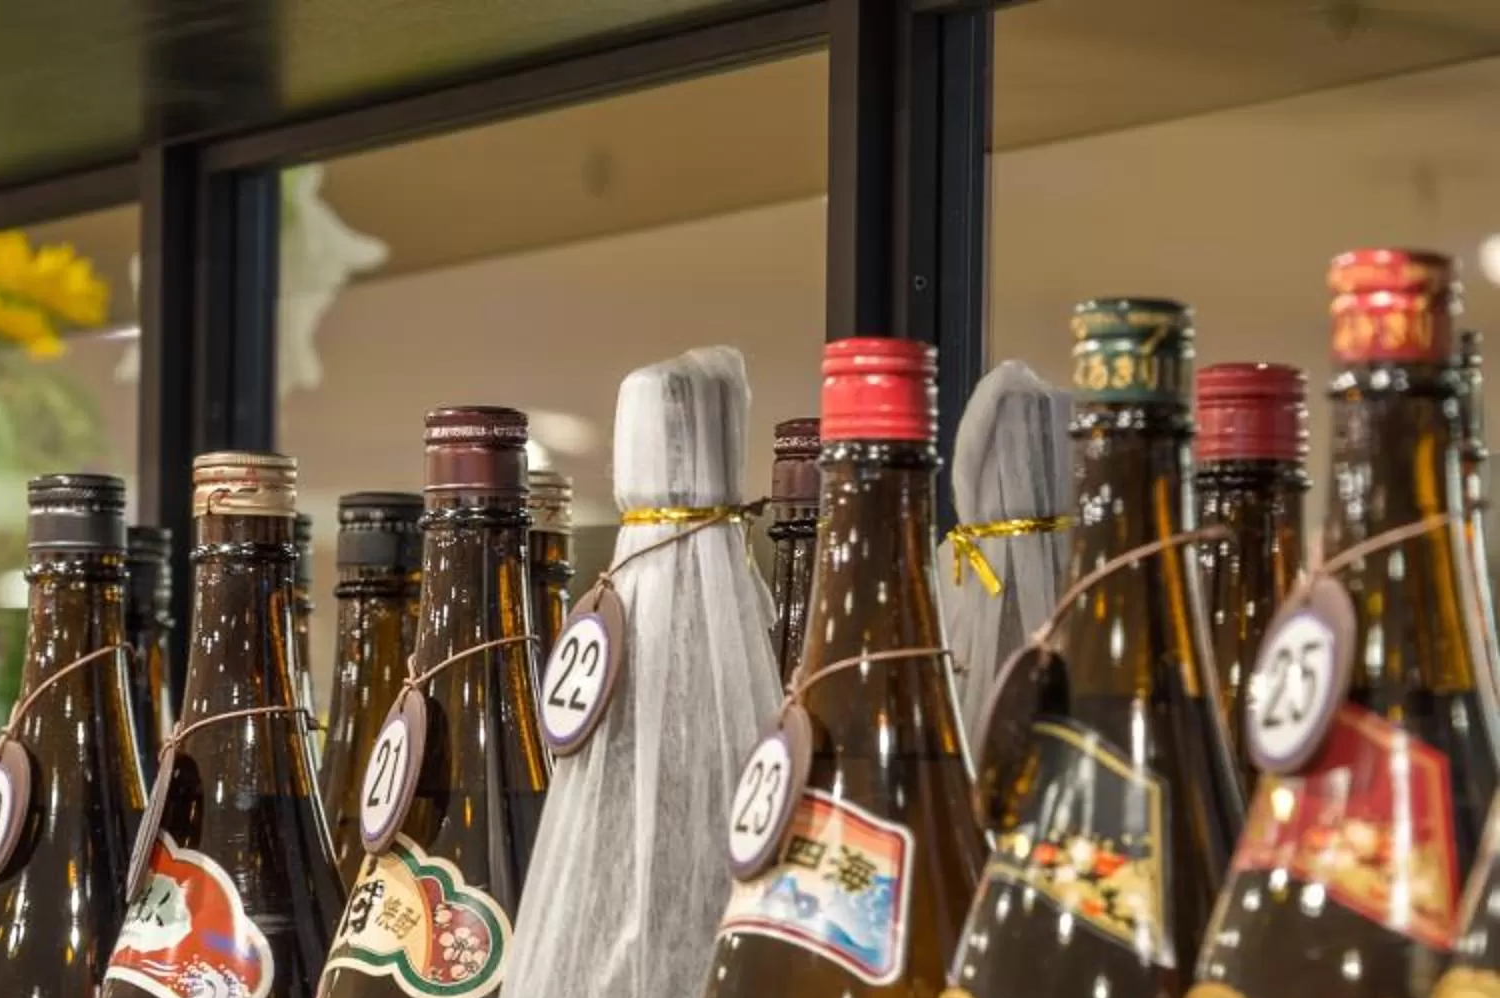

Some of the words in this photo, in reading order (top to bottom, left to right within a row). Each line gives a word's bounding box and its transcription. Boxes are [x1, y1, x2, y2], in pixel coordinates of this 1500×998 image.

[548, 636, 599, 711] 22
[1262, 640, 1324, 730] 25
[366, 736, 403, 807] 21
[735, 760, 781, 836] 23
